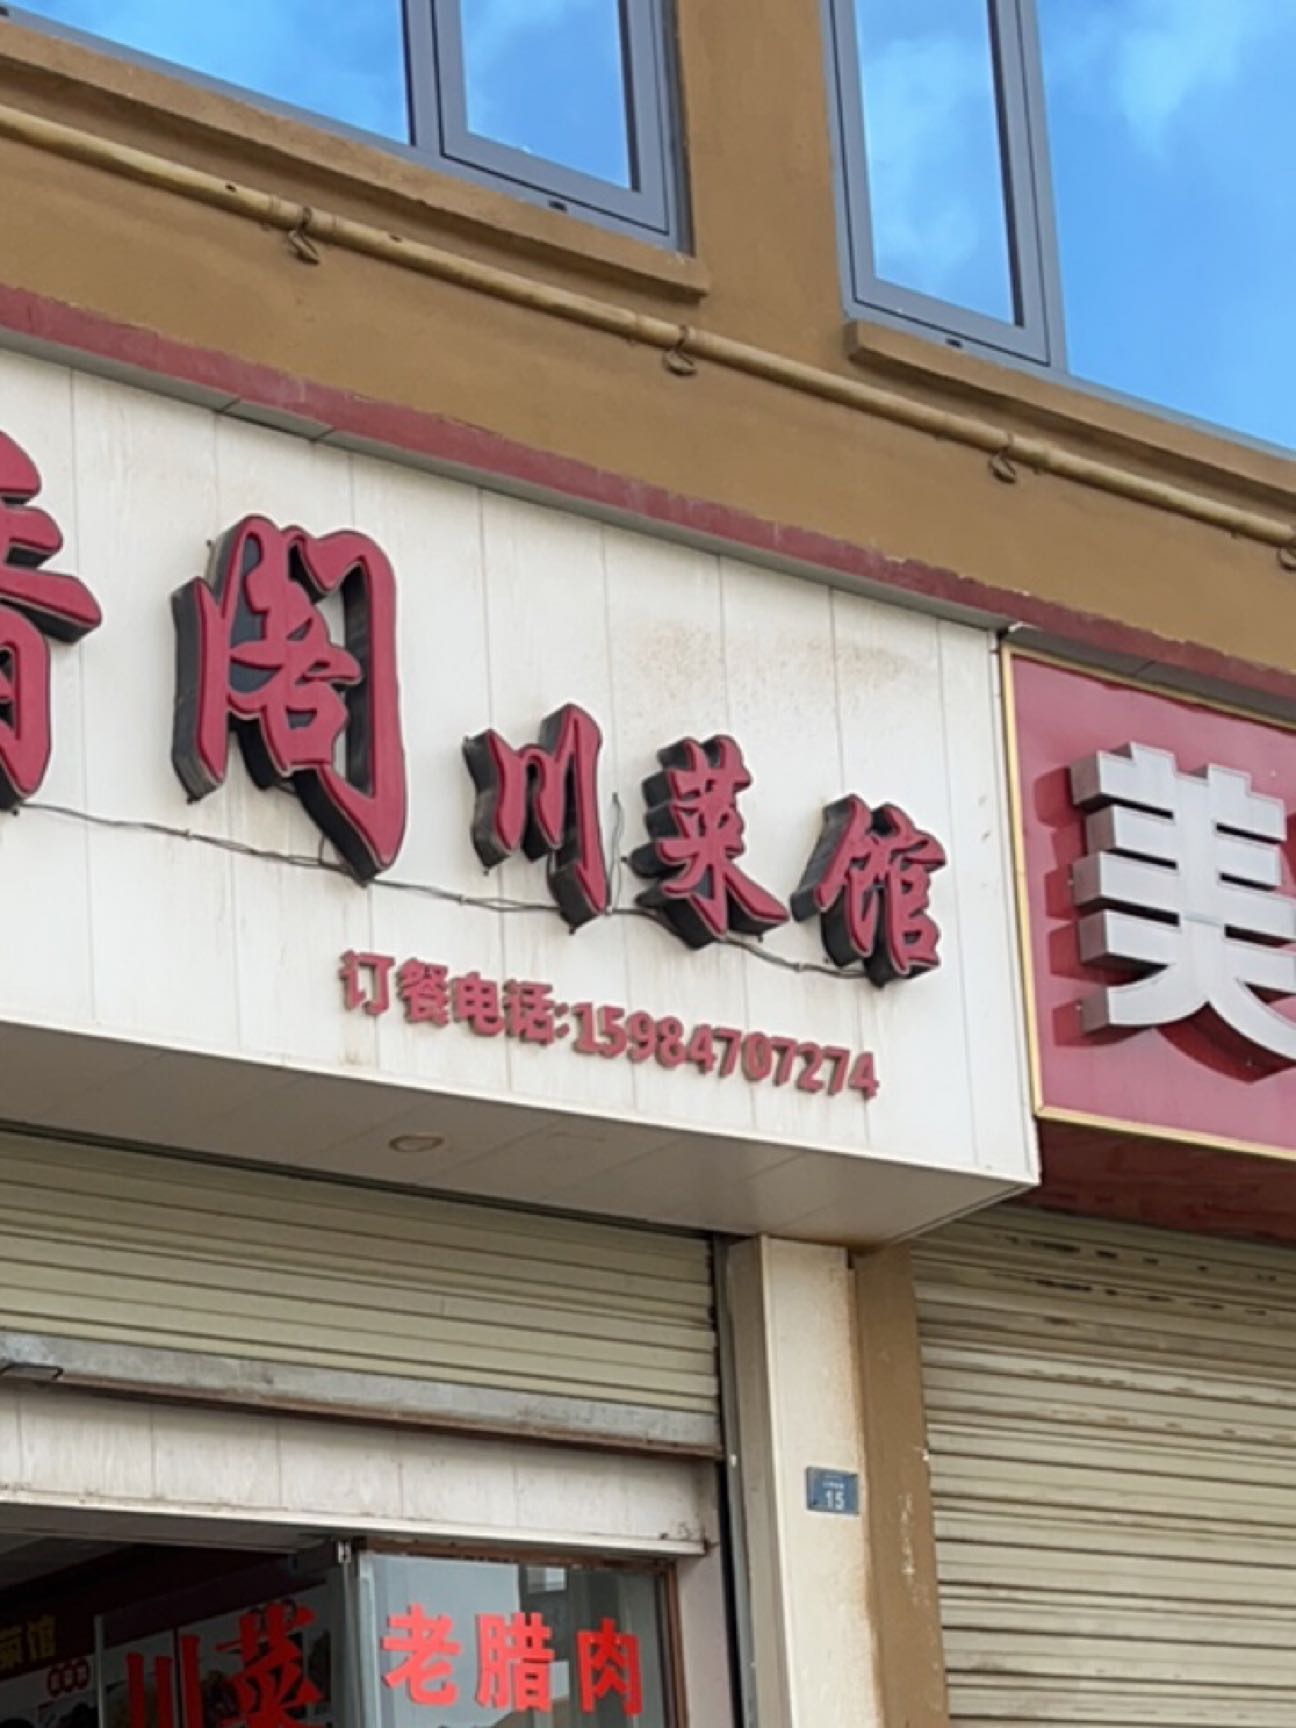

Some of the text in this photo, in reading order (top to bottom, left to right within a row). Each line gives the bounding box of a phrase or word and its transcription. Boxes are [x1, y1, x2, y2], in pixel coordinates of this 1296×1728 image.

[1069, 742, 1296, 1062] 美
[381, 1604, 644, 1718] 老腊肉
